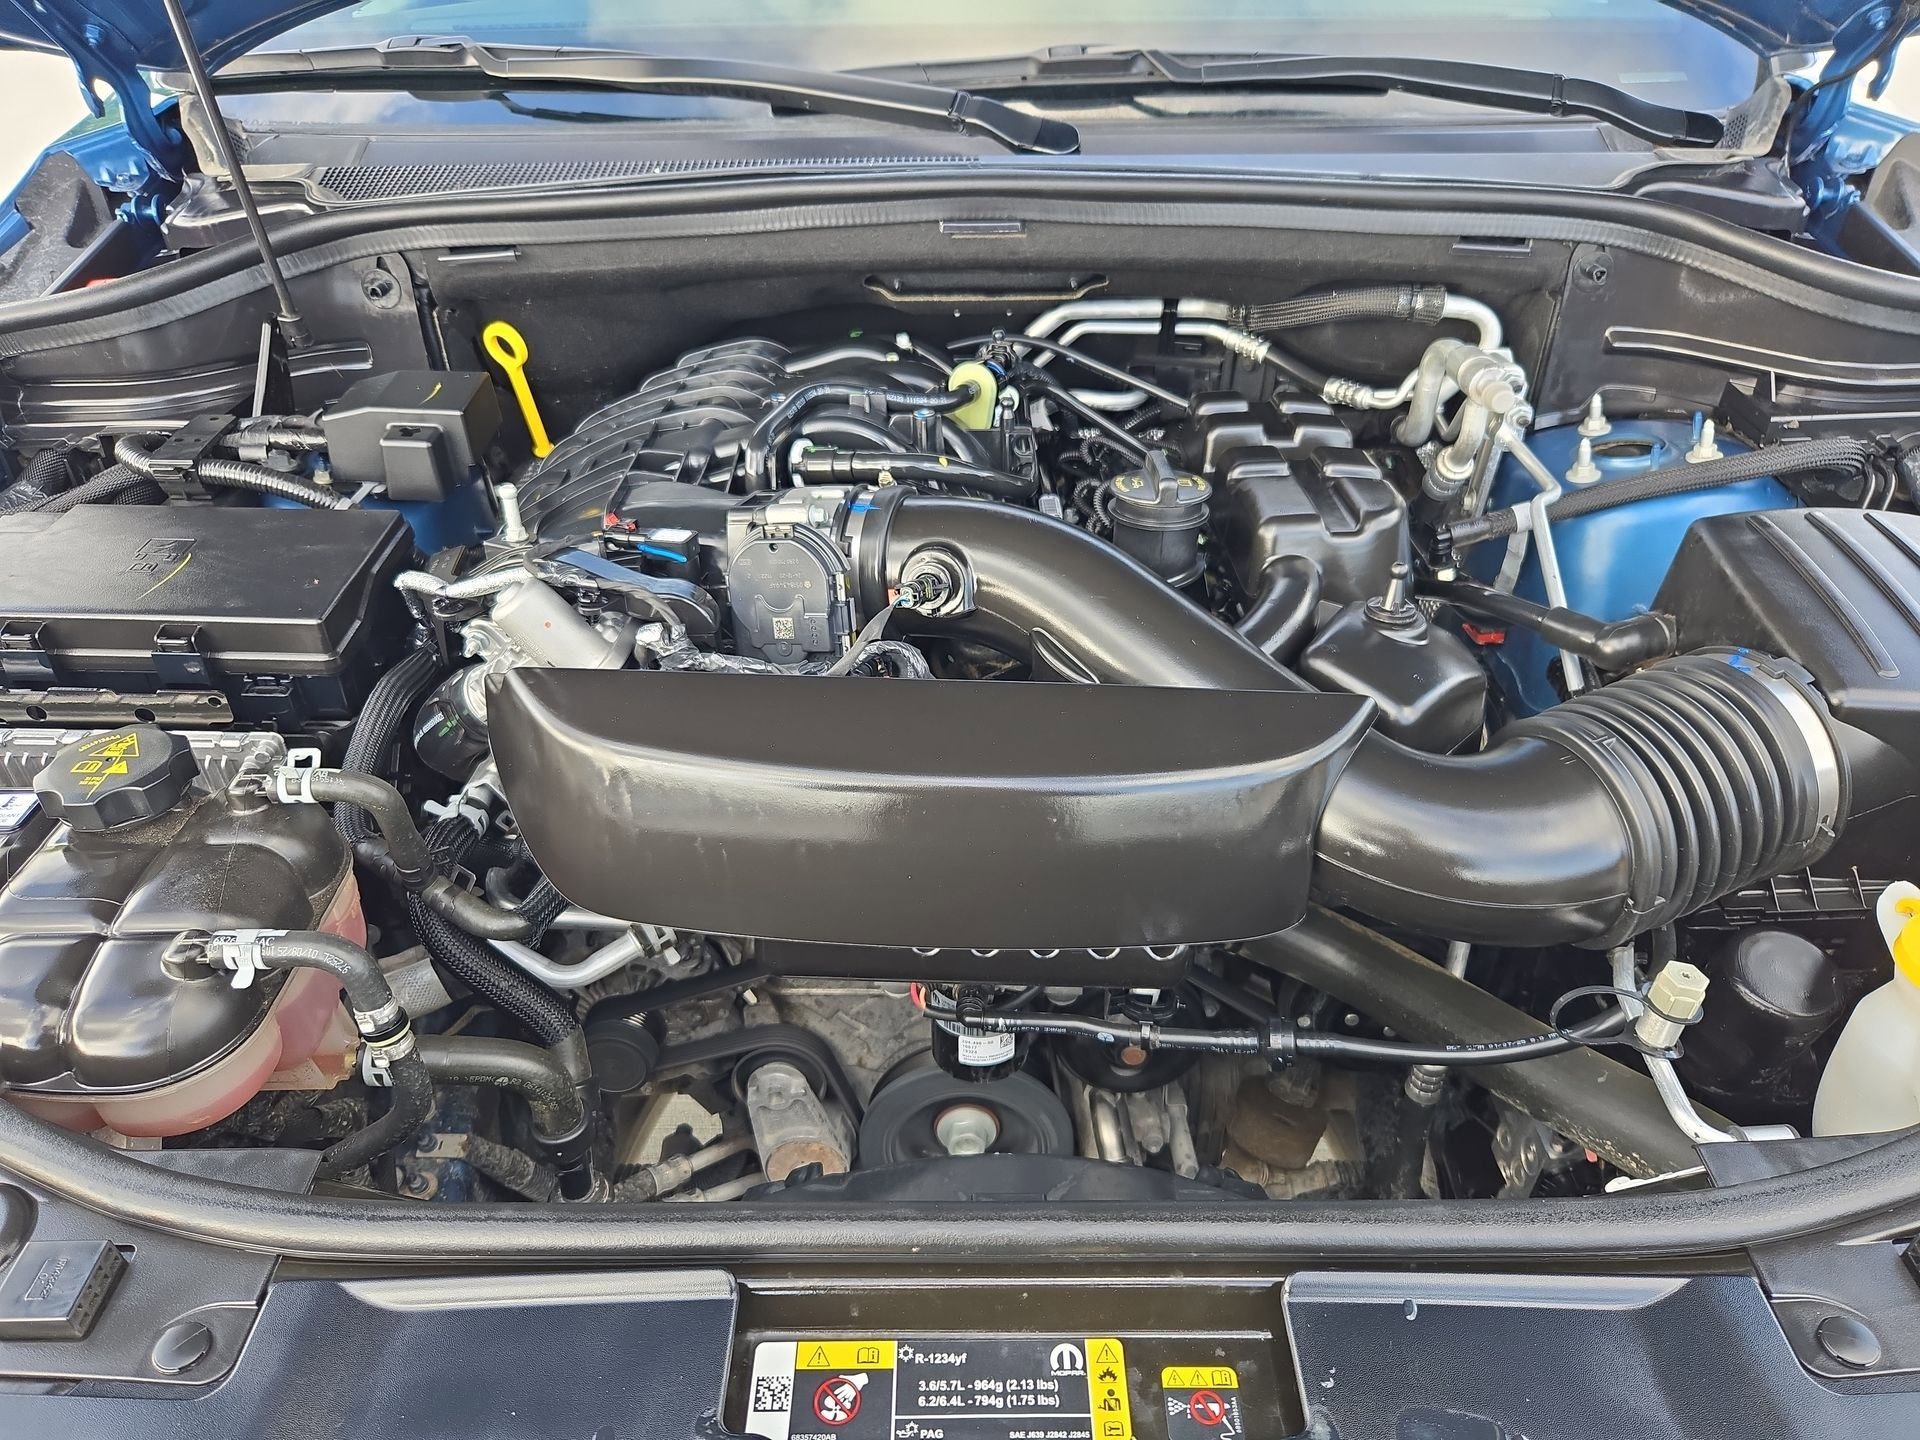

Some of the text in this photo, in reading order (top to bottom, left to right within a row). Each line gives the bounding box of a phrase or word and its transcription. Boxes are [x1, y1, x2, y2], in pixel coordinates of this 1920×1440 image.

[914, 1352, 968, 1365] R-1234yf
[918, 1380, 965, 1391] 3.6/5.7L
[974, 1380, 1004, 1393] 964g
[1006, 1379, 1035, 1393] (2.13
[1036, 1379, 1059, 1392] lbs)
[918, 1395, 965, 1407] 6.2/6.4L
[974, 1395, 1004, 1408] 794g
[1006, 1394, 1035, 1408] (1.75
[1037, 1394, 1060, 1408] lbs)
[920, 1429, 944, 1439] PAG
[1009, 1431, 1026, 1439] SAE
